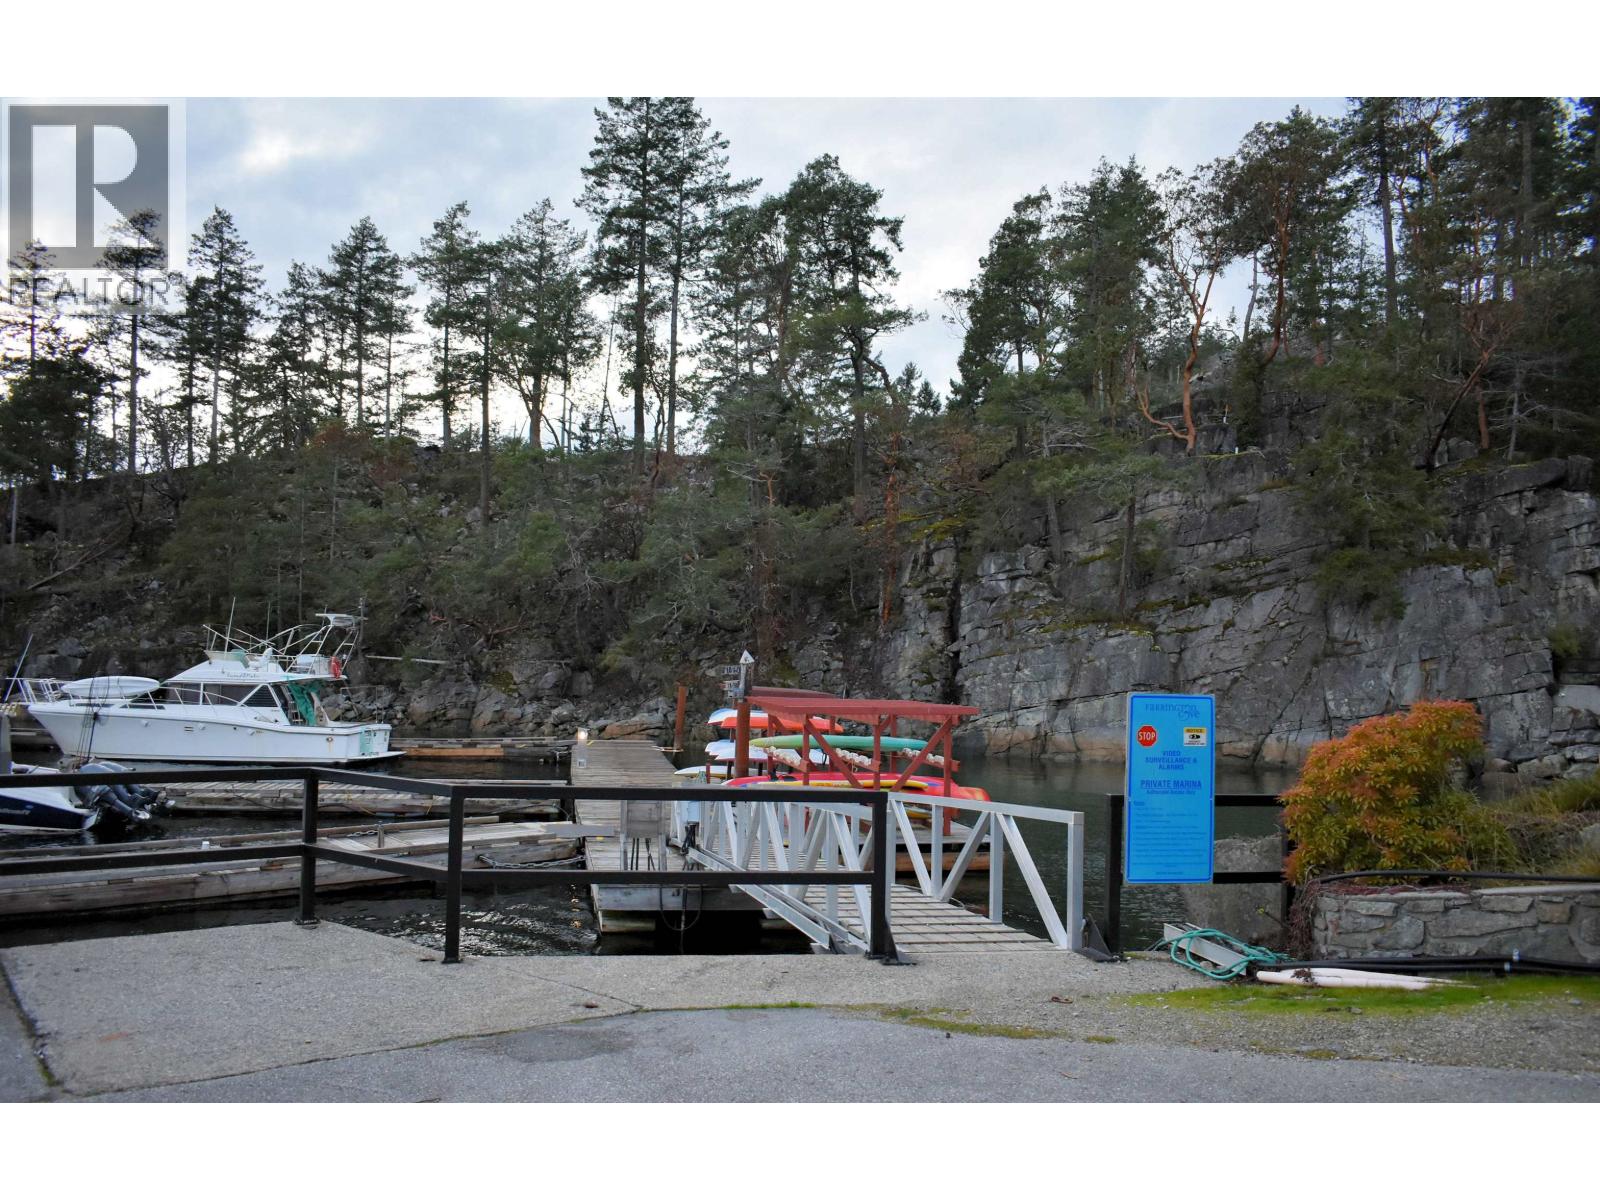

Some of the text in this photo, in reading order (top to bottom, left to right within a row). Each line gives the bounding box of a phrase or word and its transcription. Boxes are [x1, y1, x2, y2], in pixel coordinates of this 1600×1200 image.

[1138, 731, 1156, 741] STOP
[1140, 779, 1202, 790] PRIVATE MARINA
